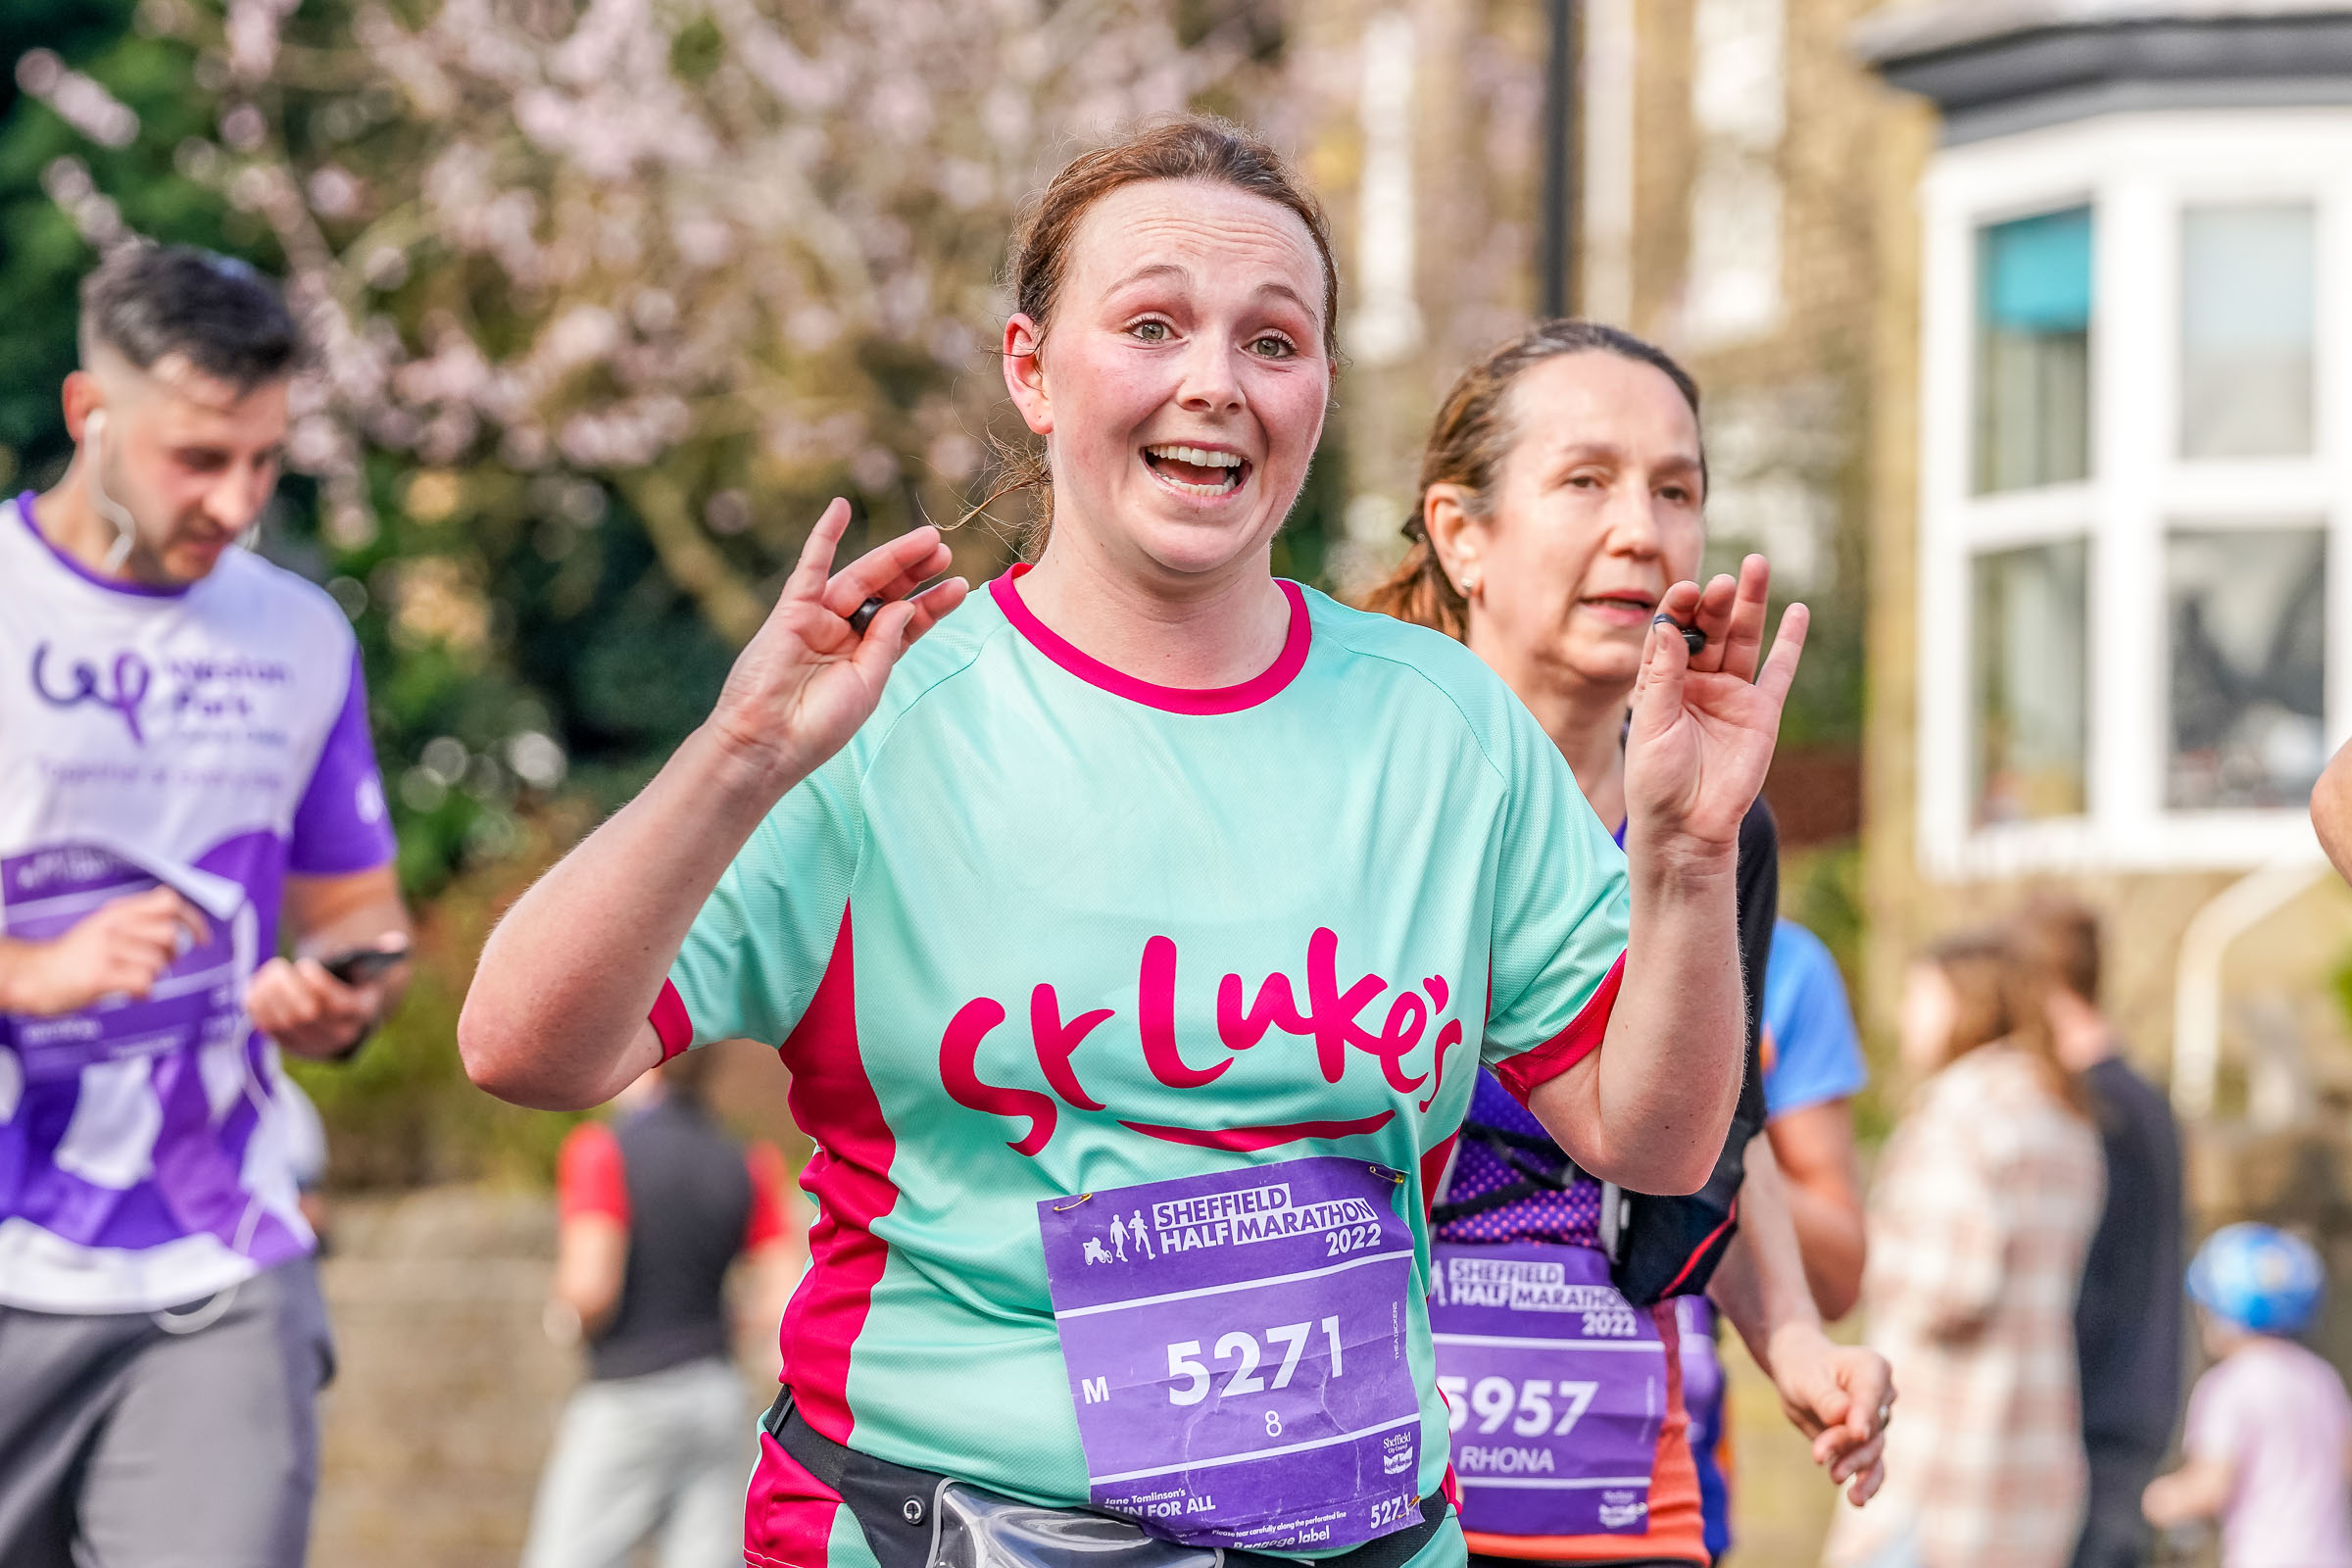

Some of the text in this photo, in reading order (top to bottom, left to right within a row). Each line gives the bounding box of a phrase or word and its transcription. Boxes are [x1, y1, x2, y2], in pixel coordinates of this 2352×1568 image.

[939, 926, 1462, 1156] St Luke's
[1157, 1188, 1288, 1227] SHEFFIELD
[1161, 1198, 1376, 1254] HALF MARATHON
[1326, 1223, 1382, 1256] 2022
[1454, 1260, 1559, 1283] SHEFFIELD
[1451, 1282, 1510, 1307] HALF
[1581, 1310, 1638, 1337] 2022
[1167, 1314, 1343, 1406] 5271
[1082, 1376, 1109, 1404] M
[1436, 1375, 1599, 1438] 5957
[1264, 1410, 1283, 1438] 8
[1383, 1431, 1411, 1449] Sheffield
[1458, 1446, 1555, 1472] RHONA
[1131, 1487, 1186, 1505] Tomlinson's
[1148, 1500, 1182, 1518] FOR
[1186, 1494, 1216, 1514] ALL
[1211, 1529, 1235, 1538] Please
[1250, 1524, 1277, 1536] carefully
[1277, 1522, 1295, 1531] along
[1304, 1512, 1336, 1528] perforated
[1336, 1510, 1348, 1519] line
[1370, 1493, 1410, 1529] 5271
[1298, 1524, 1330, 1544] label
